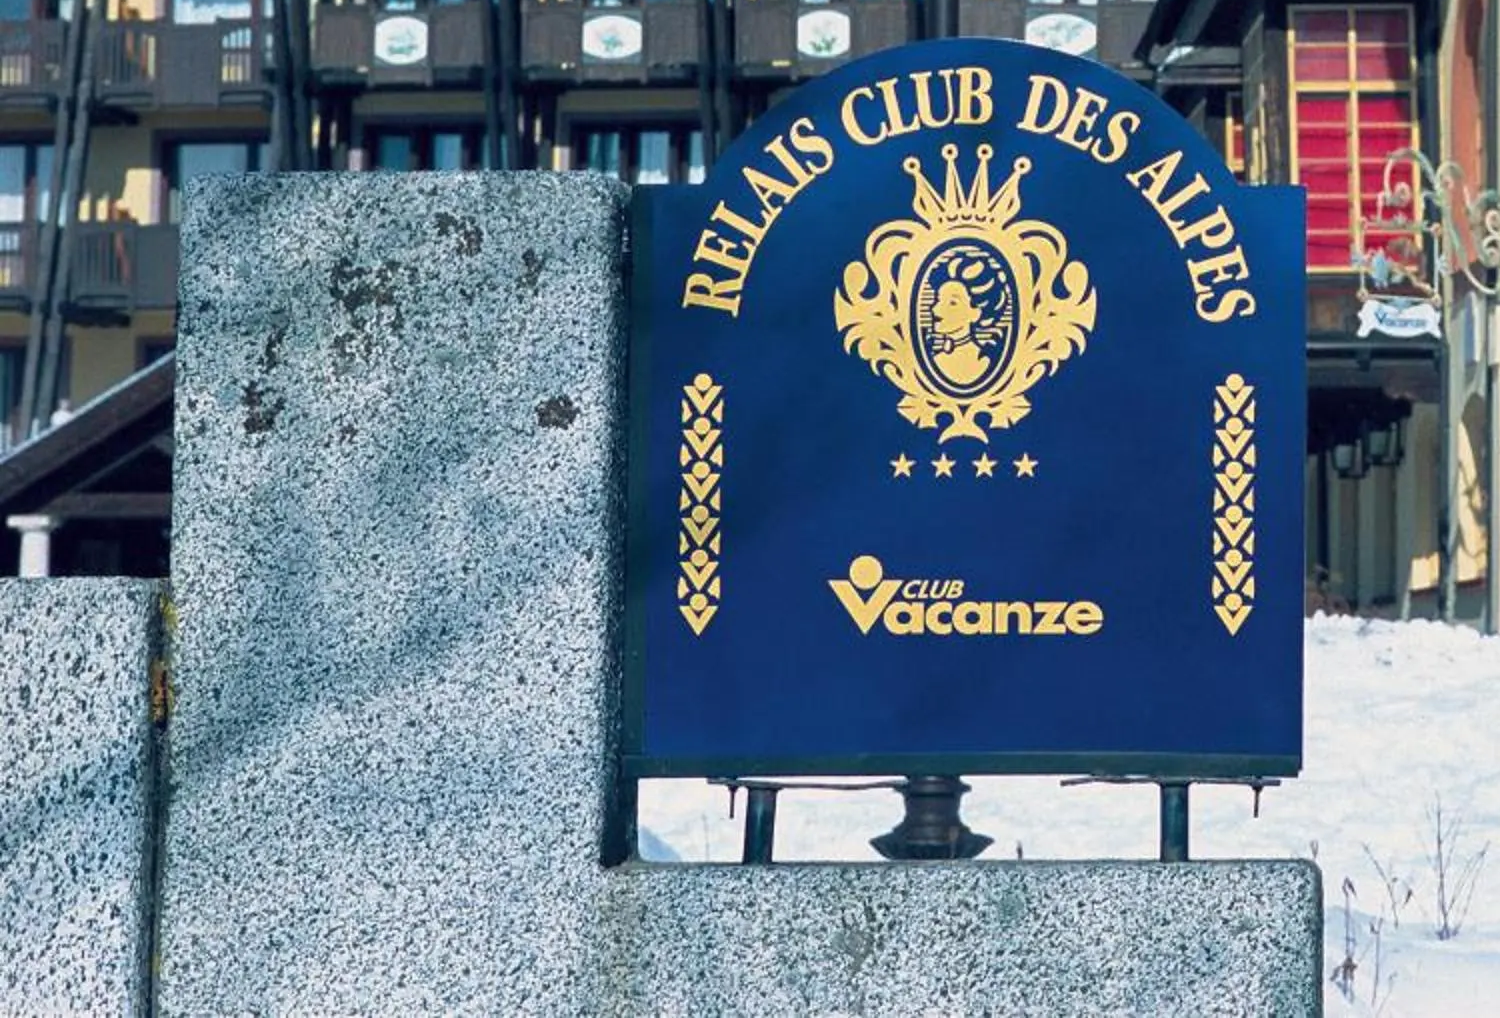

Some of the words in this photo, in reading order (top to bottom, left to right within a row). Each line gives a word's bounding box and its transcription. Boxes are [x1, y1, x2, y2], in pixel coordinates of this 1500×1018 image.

[683, 117, 834, 317] RELAIS
[841, 67, 993, 145] CLUB
[1017, 75, 1141, 164] DES
[1126, 150, 1256, 323] ALPES
[828, 579, 1103, 635] Vacanze
[902, 579, 965, 599] CLUB
